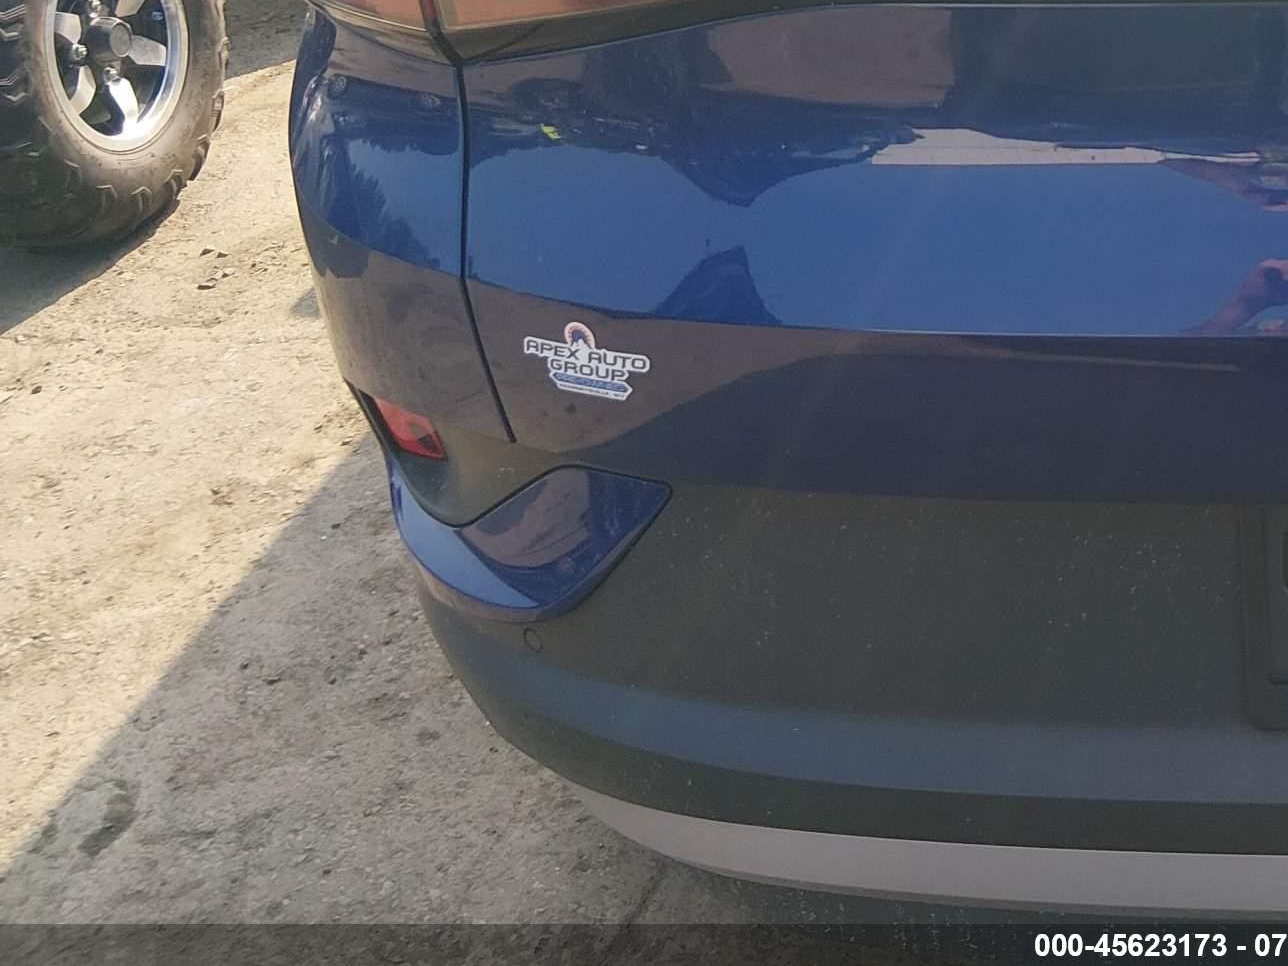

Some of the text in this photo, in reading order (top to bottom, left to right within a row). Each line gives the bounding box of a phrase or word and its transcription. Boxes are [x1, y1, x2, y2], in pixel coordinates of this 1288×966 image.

[525, 339, 648, 371] APEX AUTO
[550, 358, 626, 381] GROUP
